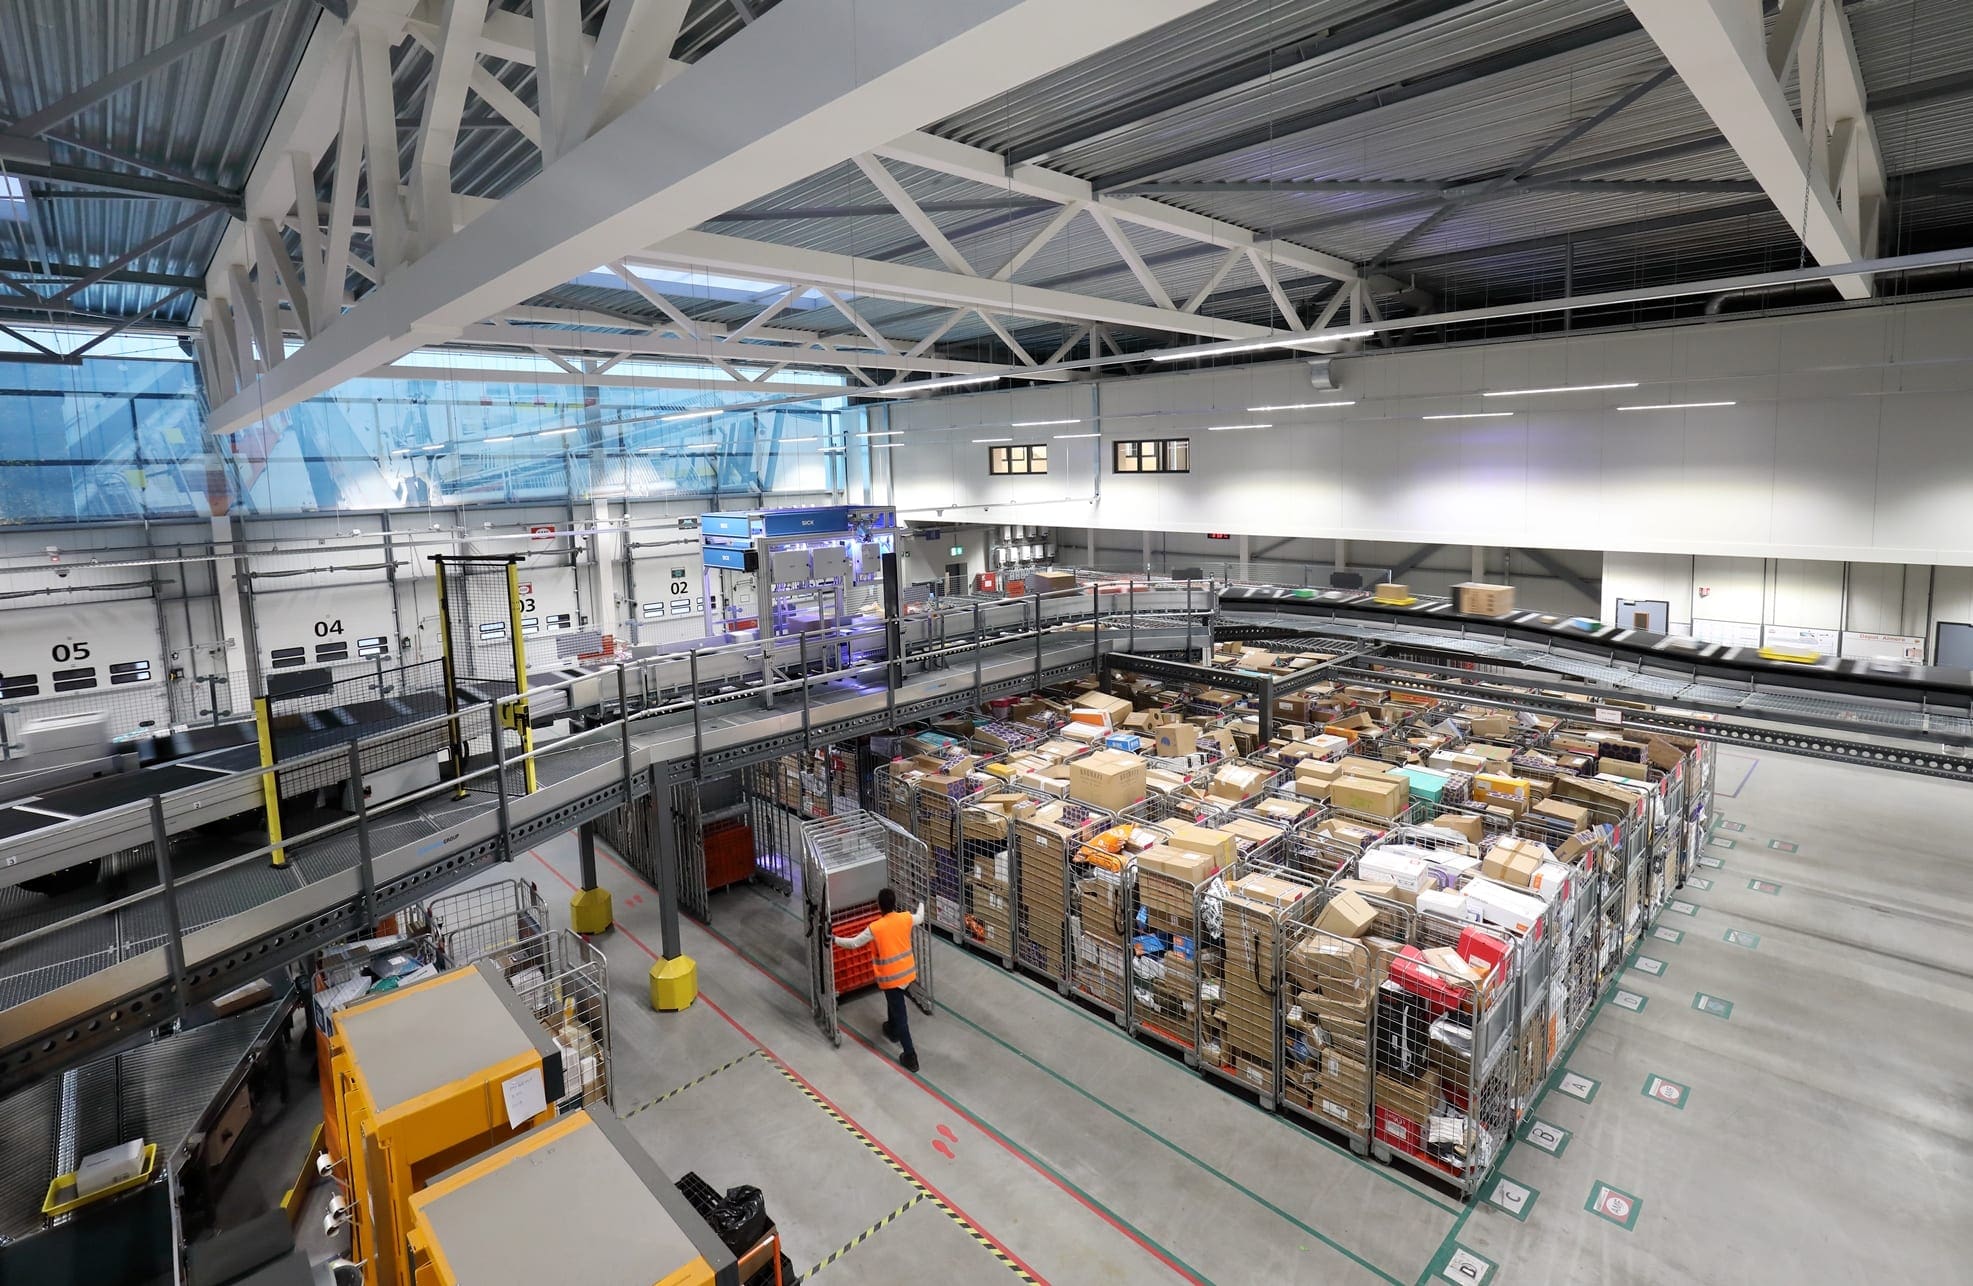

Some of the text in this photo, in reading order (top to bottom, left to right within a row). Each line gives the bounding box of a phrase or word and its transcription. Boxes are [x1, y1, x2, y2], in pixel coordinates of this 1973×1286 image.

[670, 581, 689, 595] 02
[314, 619, 345, 637] 04
[52, 642, 91, 662] 05
[1572, 1082, 1587, 1092] A
[1532, 1127, 1555, 1143] B
[1505, 1191, 1522, 1203] C
[1460, 1263, 1477, 1279] D
